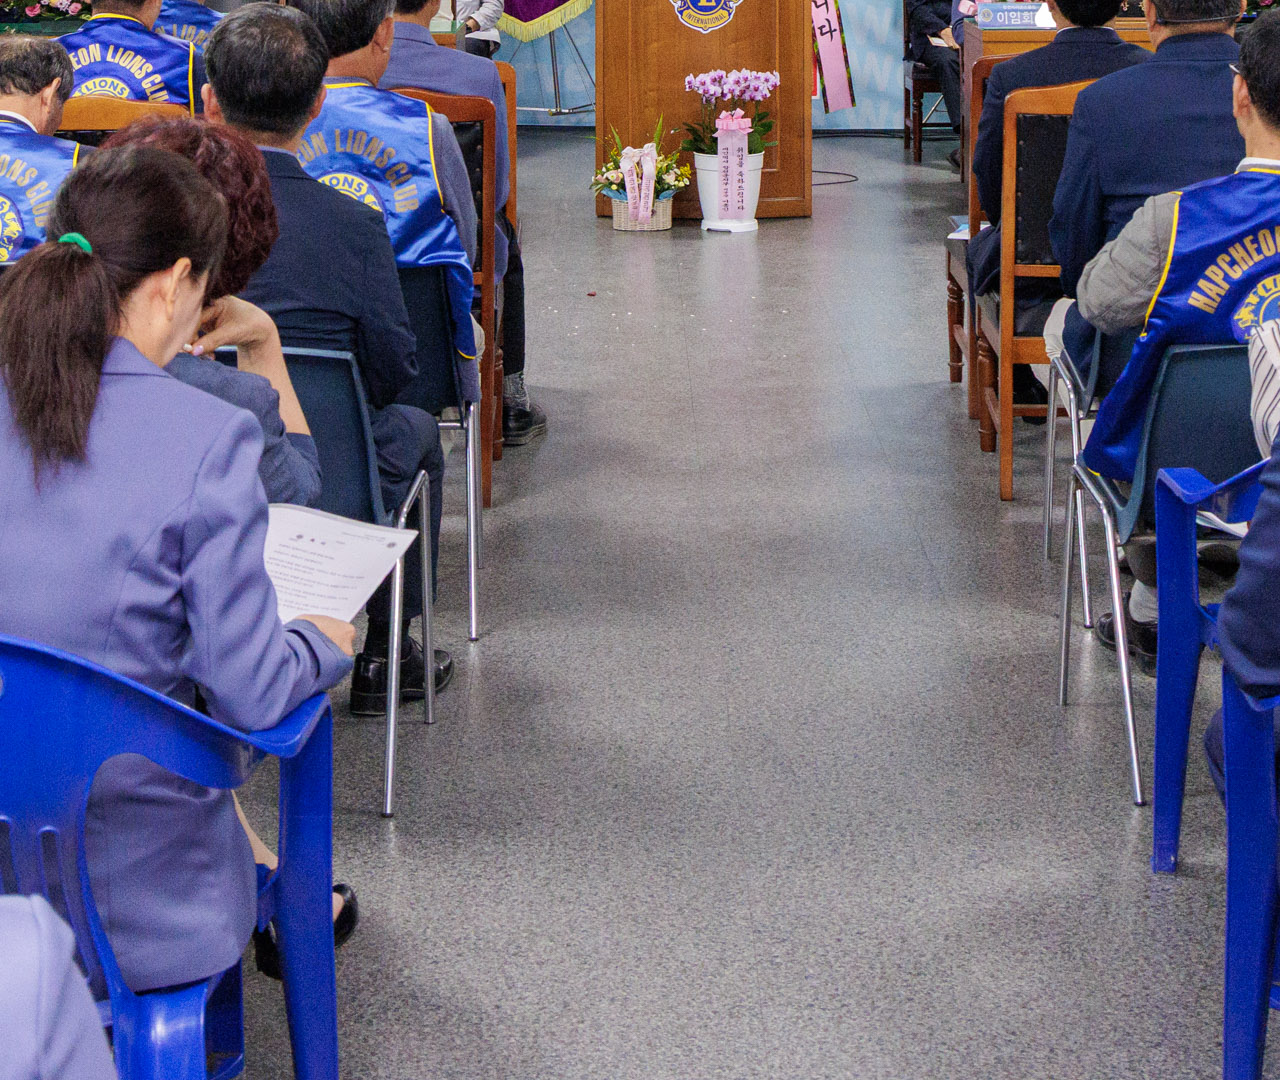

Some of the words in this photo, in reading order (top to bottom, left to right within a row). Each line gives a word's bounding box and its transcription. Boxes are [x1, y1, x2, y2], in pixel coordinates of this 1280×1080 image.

[685, 12, 726, 25] INTERNATIONAL
[997, 11, 1036, 25] 이임회
[69, 44, 101, 72] EON
[106, 45, 153, 79] LIONS
[86, 79, 126, 97] LIONS
[335, 129, 396, 168] LIONS
[385, 162, 419, 212] CLUB
[321, 176, 364, 193] ONS
[26, 181, 54, 227] CLUB
